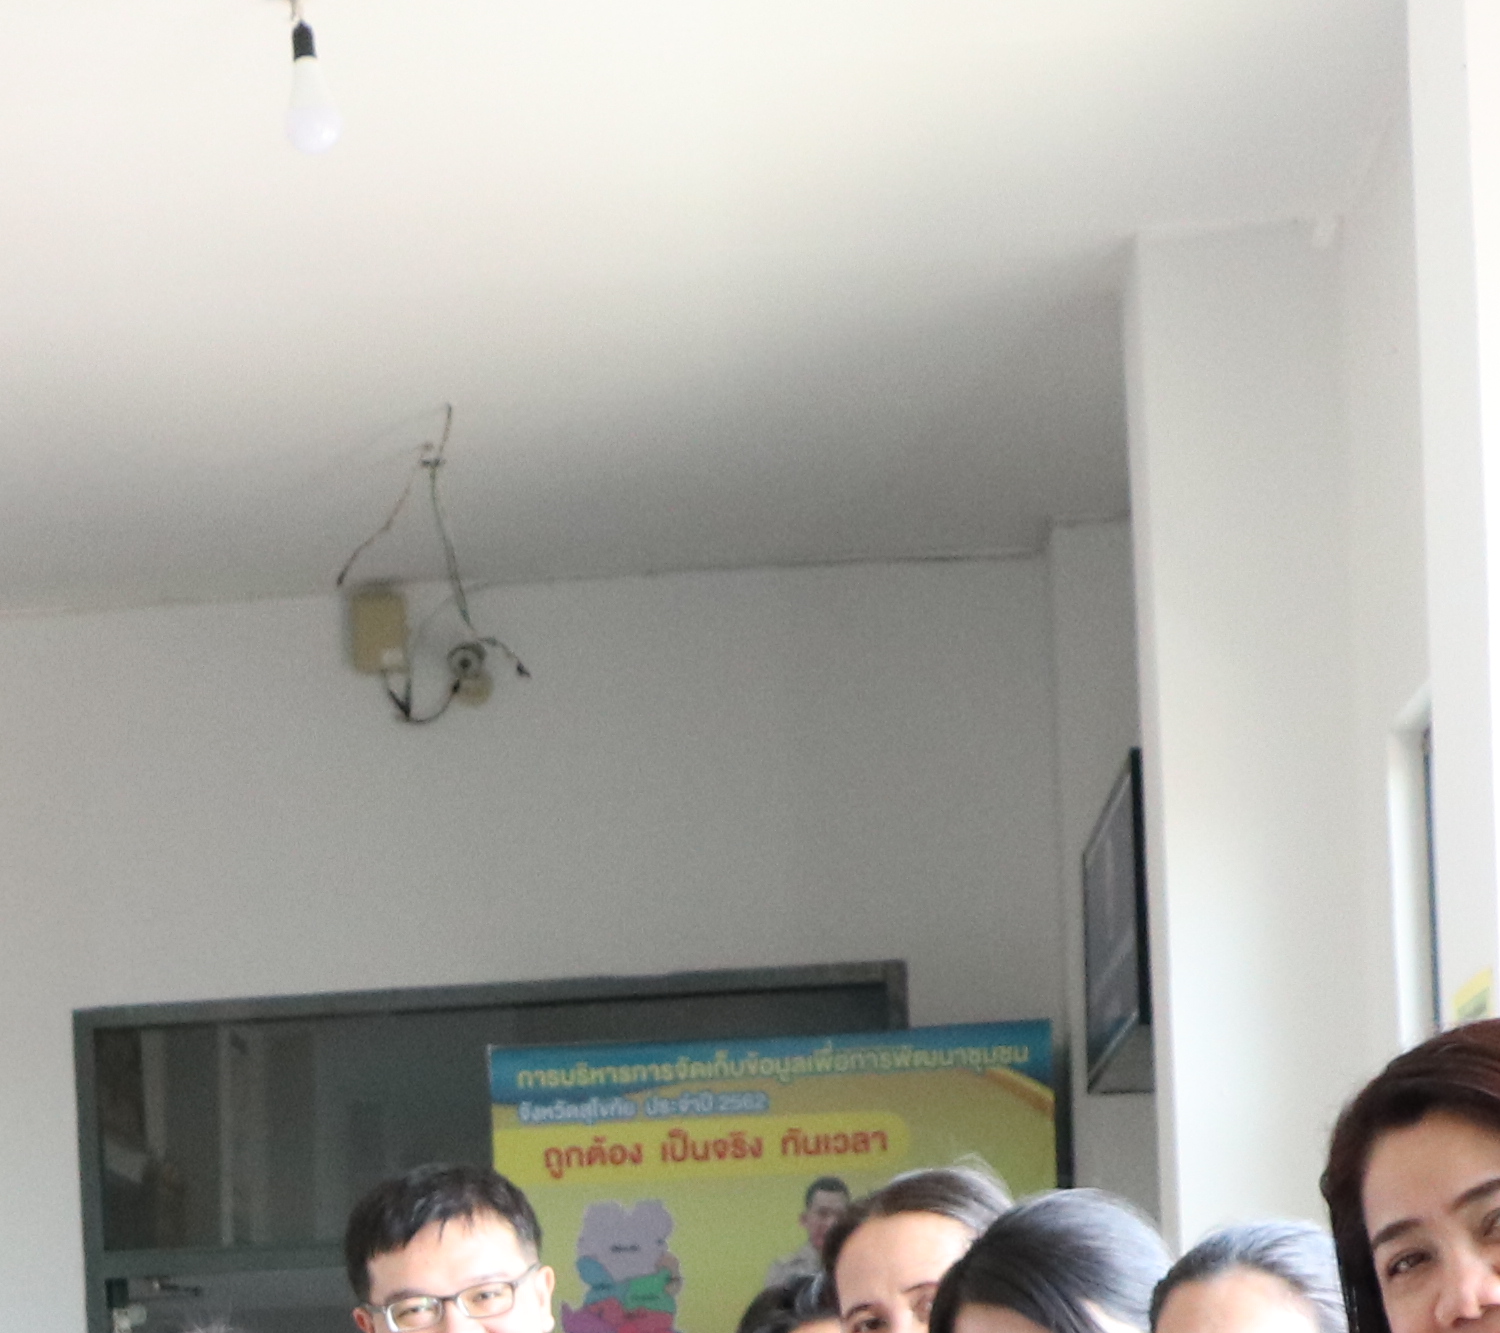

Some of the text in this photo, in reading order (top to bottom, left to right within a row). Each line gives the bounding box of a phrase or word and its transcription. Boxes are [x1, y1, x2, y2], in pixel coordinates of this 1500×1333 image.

[543, 1126, 889, 1180] ถูกต้อง เป็นจริง ทันเวลา
